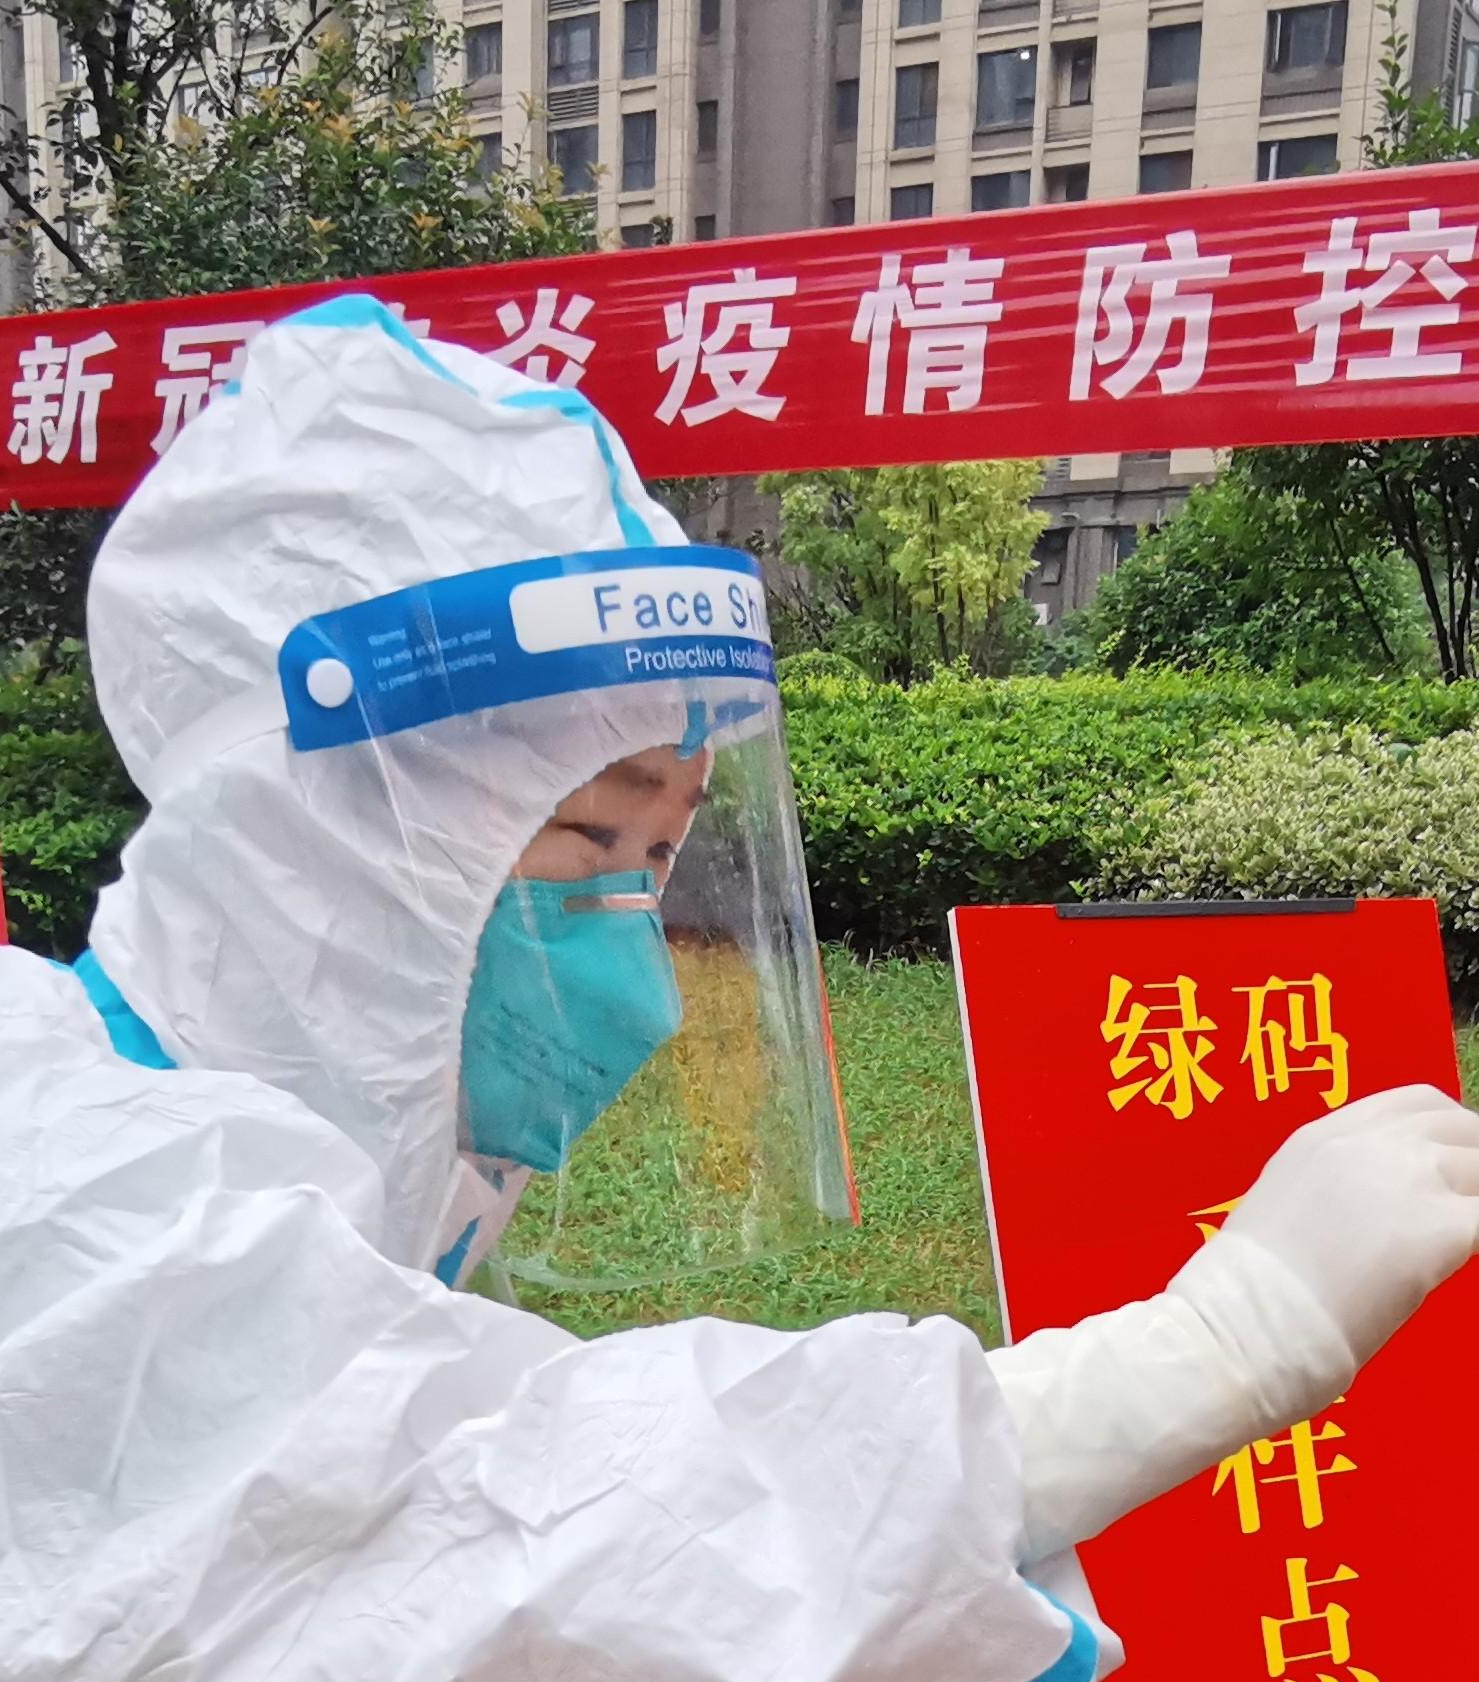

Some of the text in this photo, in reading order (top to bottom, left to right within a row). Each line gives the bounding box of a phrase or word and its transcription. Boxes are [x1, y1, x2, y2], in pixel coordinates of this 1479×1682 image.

[593, 583, 714, 634] Face
[625, 643, 727, 673] Protective
[1099, 972, 1352, 1121] 绿码
